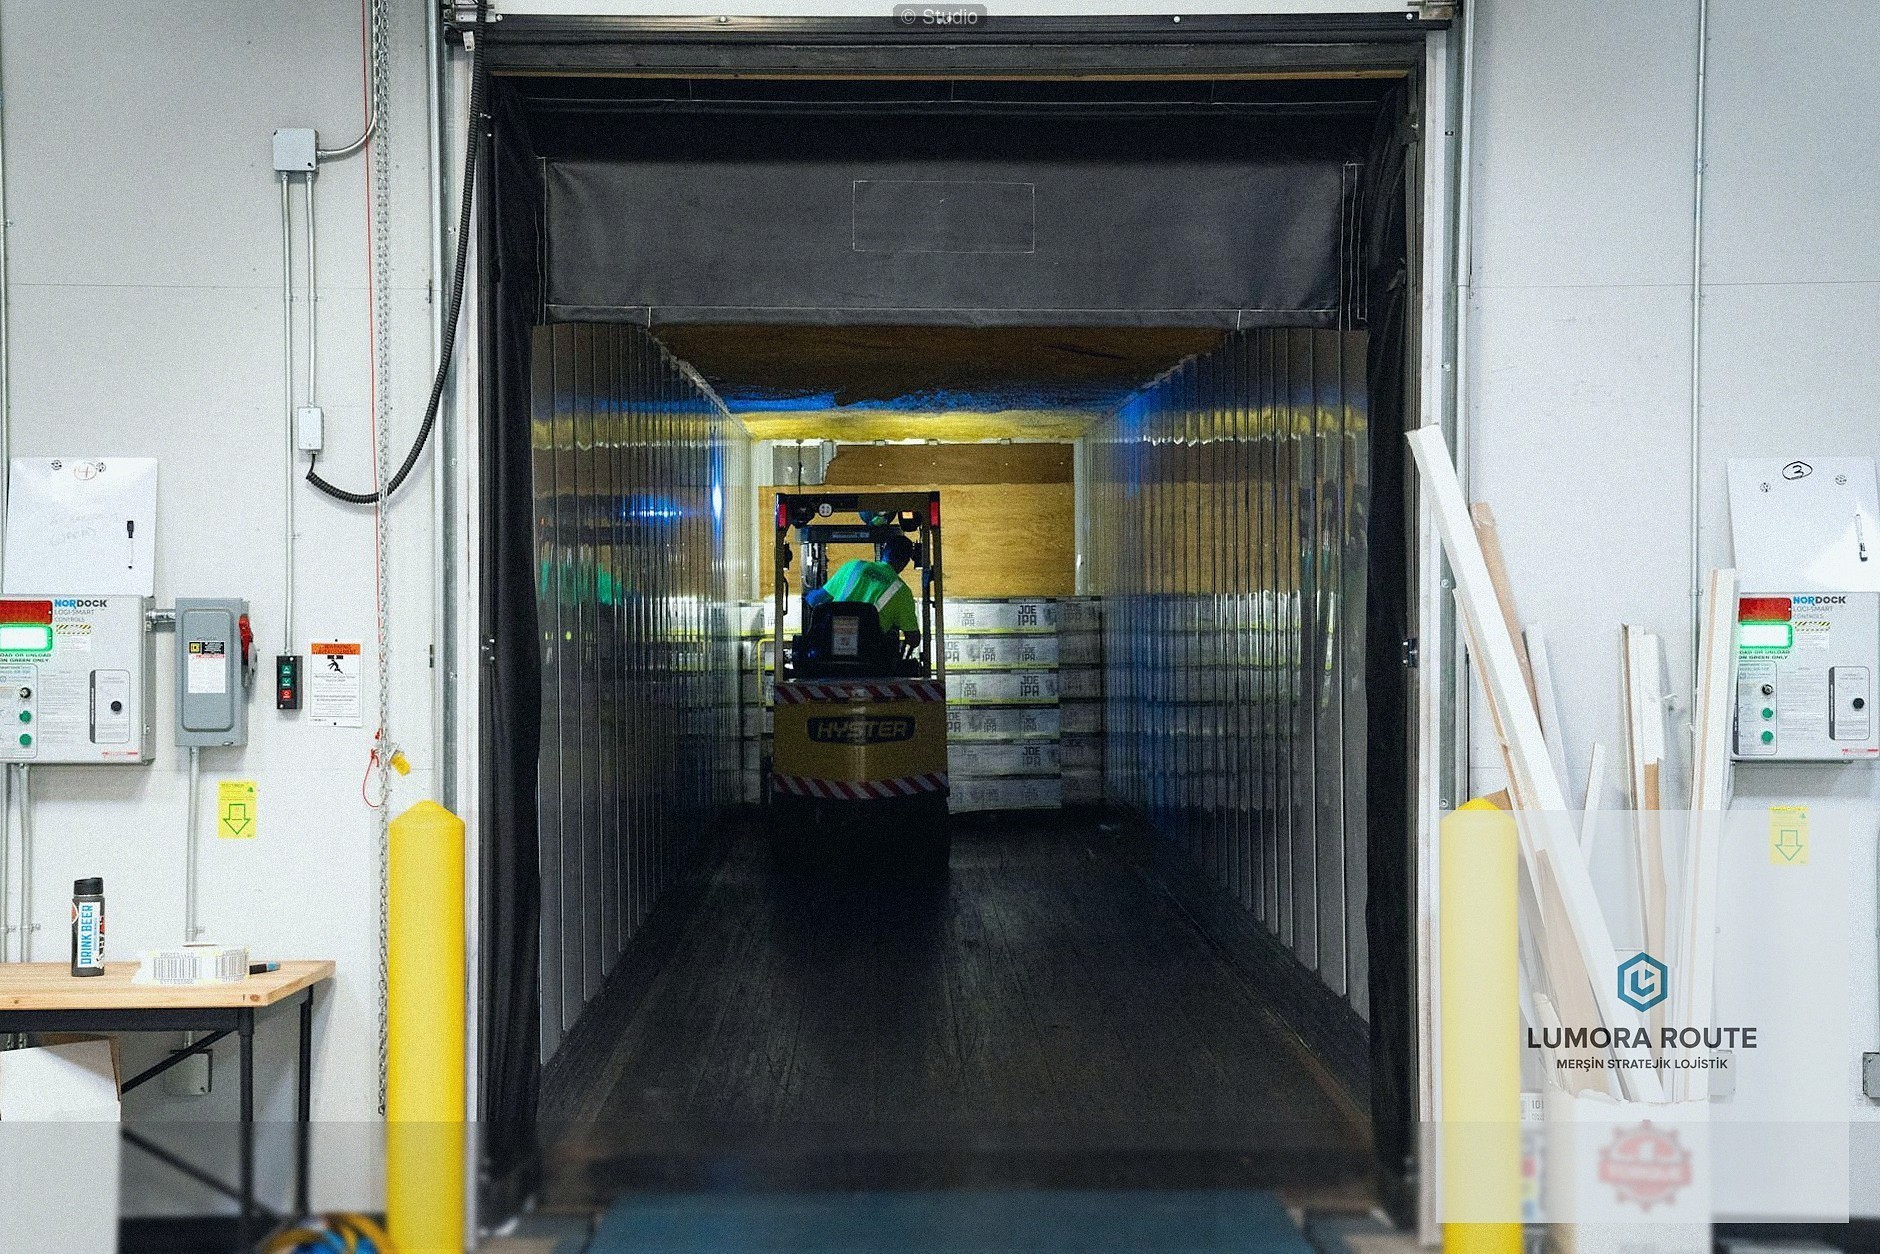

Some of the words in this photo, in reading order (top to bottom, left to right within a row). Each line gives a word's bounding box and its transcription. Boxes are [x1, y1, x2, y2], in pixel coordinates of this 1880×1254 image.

[1792, 464, 1804, 479] 3
[54, 599, 108, 609] NORDOCK
[1793, 596, 1847, 606] NORDOCK
[1018, 605, 1037, 614] JOE
[1018, 615, 1037, 626] IPA
[1020, 676, 1039, 685] JOE
[1020, 685, 1040, 697] IPA
[817, 721, 907, 738] HYSTER
[1023, 746, 1040, 756] JOE
[1022, 756, 1041, 767] IPA
[81, 905, 93, 932] BEER
[81, 934, 92, 965] DRINK
